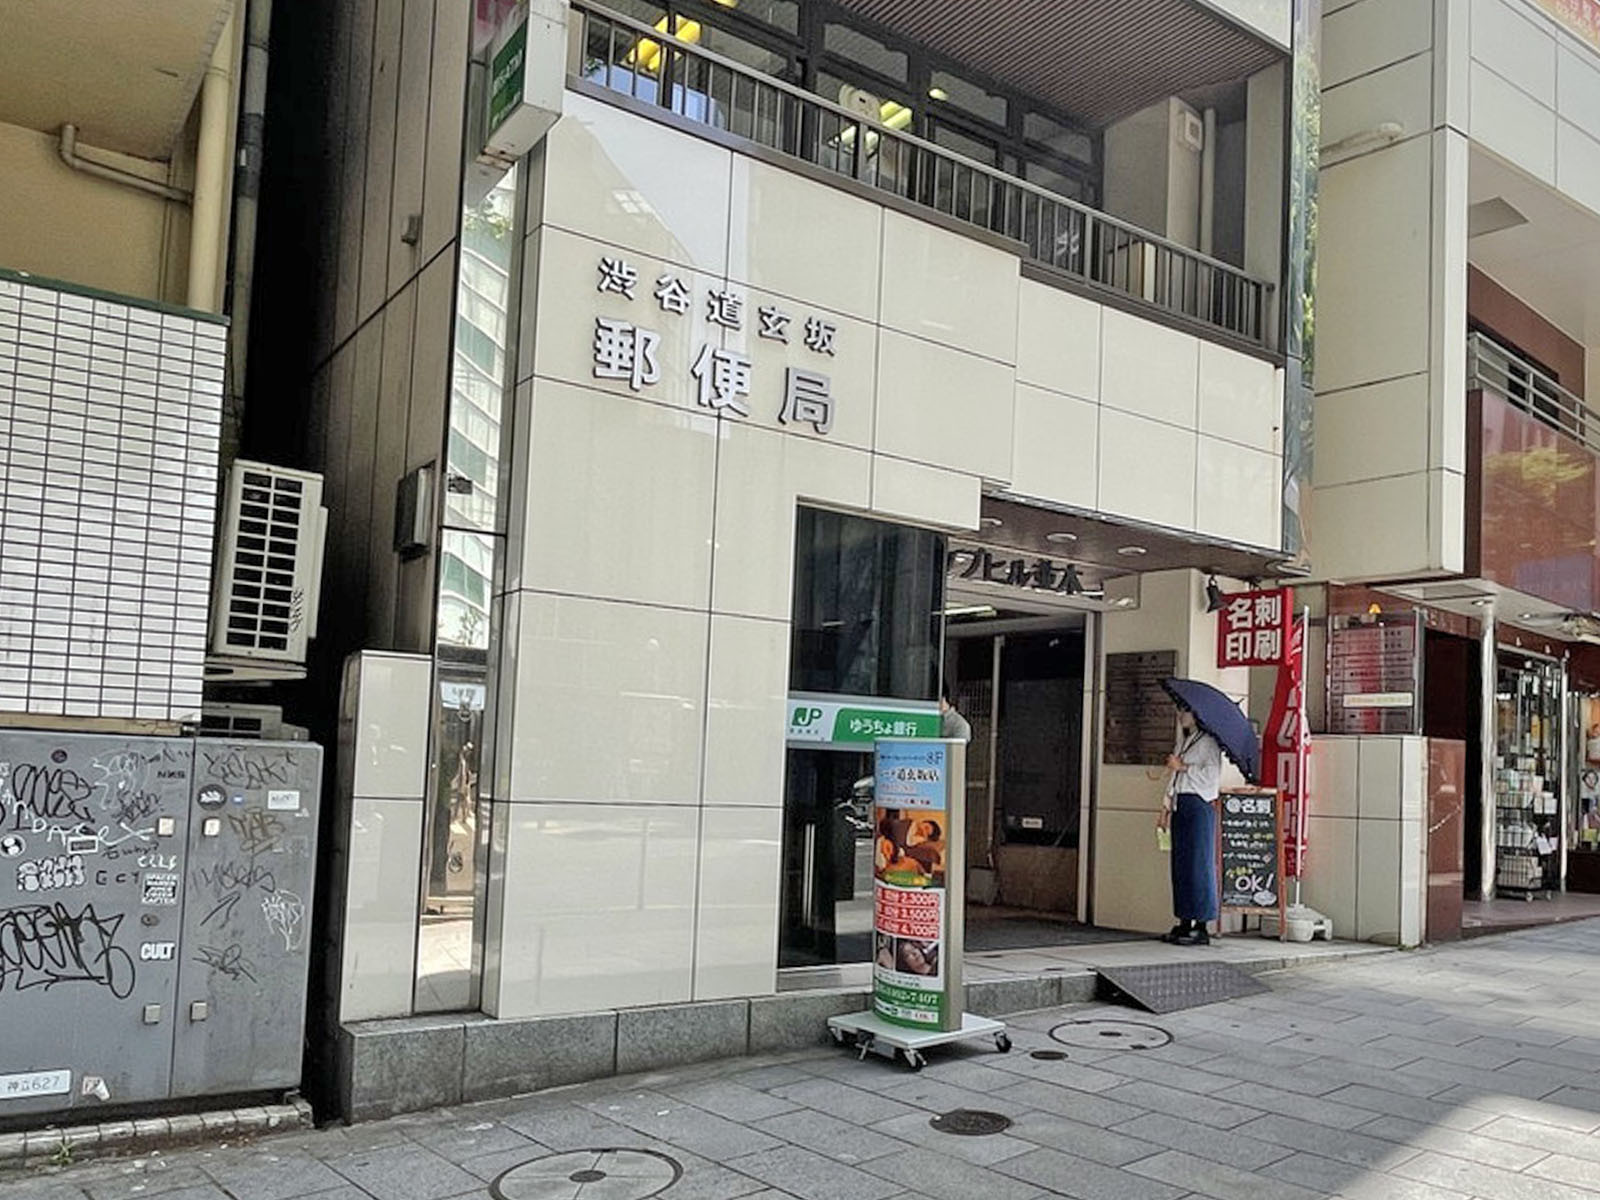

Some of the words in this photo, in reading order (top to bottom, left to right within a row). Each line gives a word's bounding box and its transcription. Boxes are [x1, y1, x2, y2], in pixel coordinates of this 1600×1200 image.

[597, 257, 837, 357] 渋谷道玄坂
[594, 317, 835, 434] 郵便局
[1227, 595, 1281, 629] 名刺
[1226, 629, 1281, 661] 印刷
[791, 707, 822, 727] JP
[850, 718, 917, 737] ゆうちょ銀行
